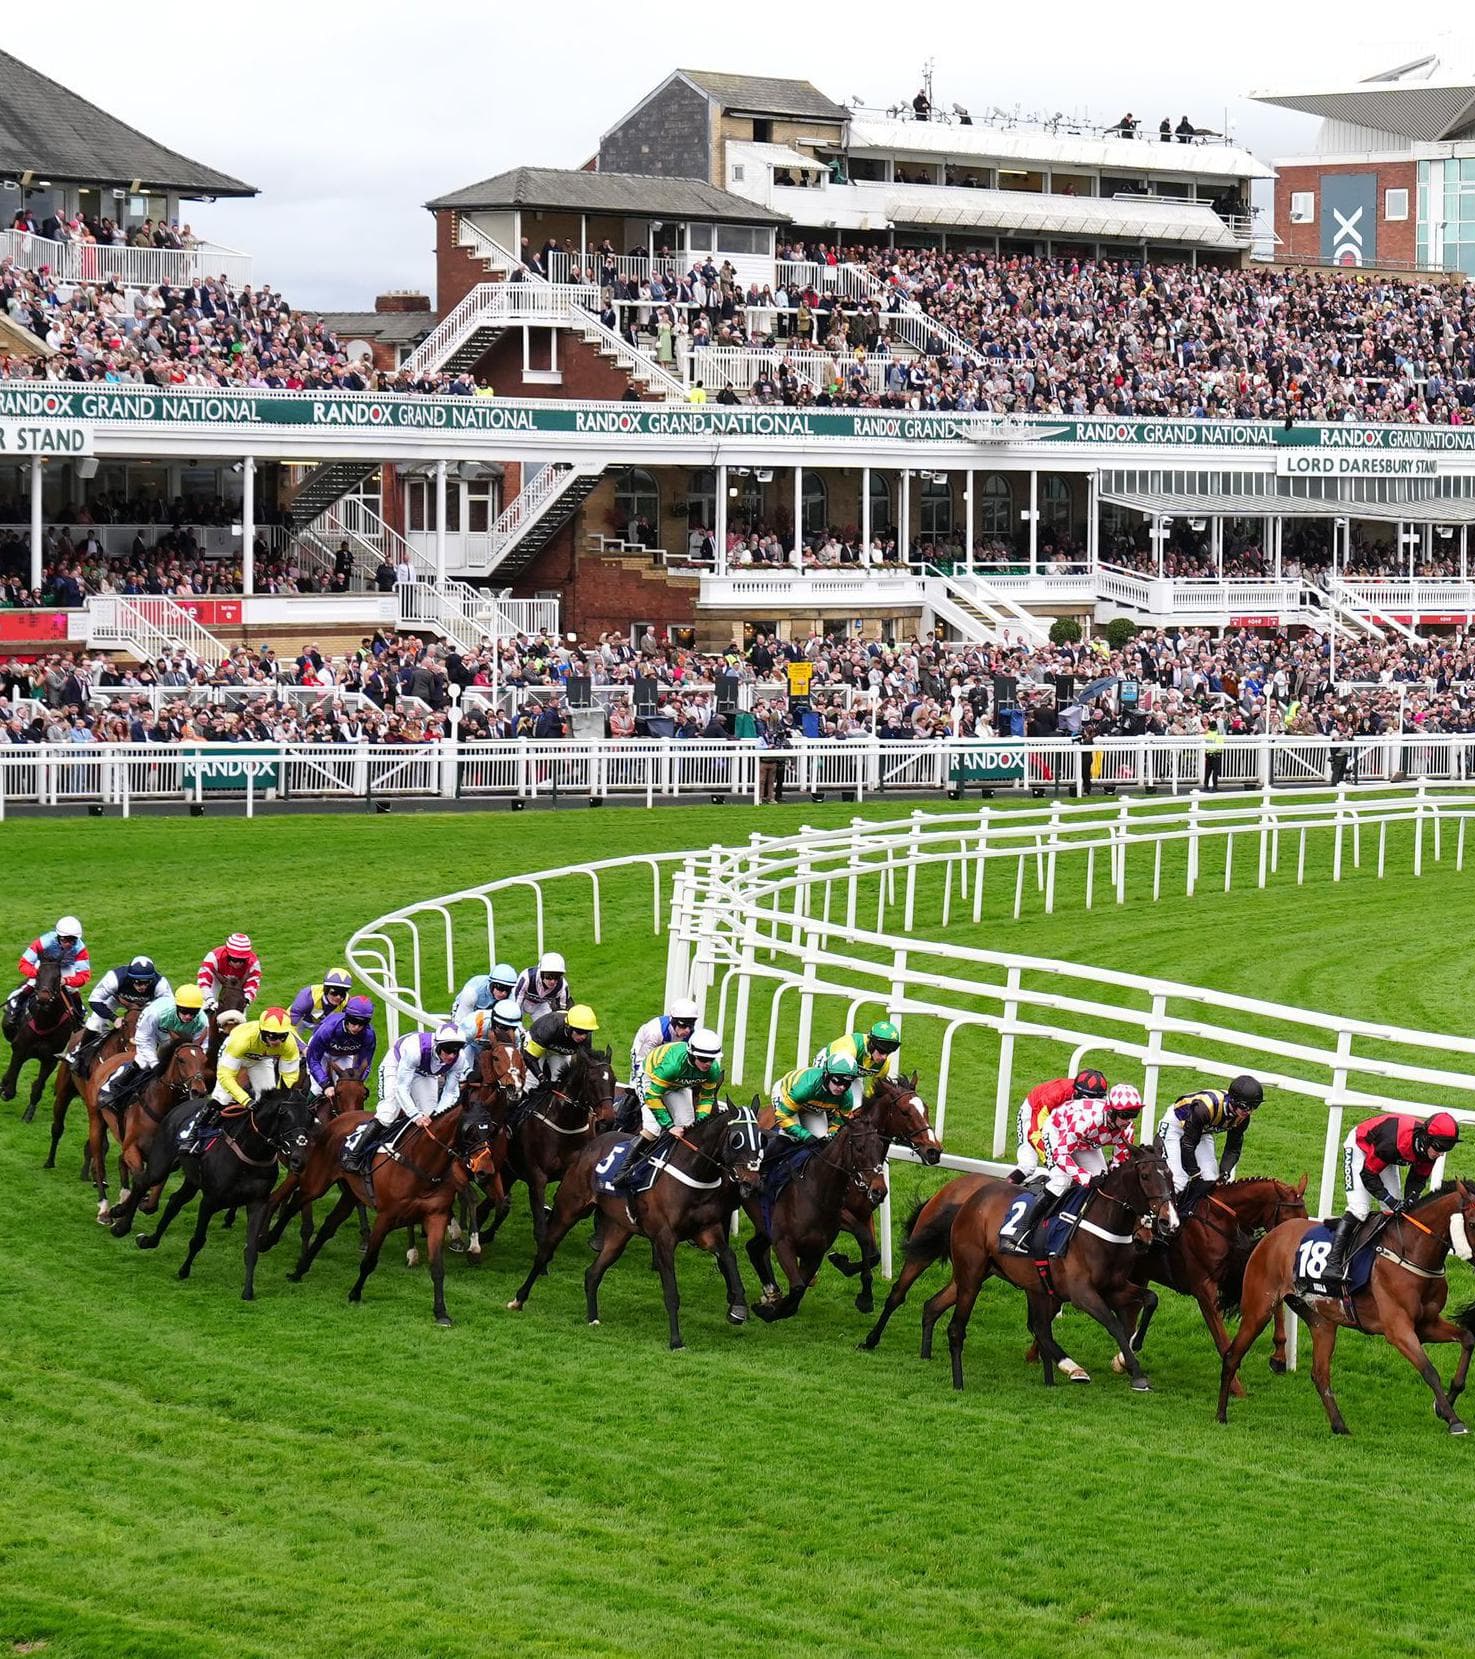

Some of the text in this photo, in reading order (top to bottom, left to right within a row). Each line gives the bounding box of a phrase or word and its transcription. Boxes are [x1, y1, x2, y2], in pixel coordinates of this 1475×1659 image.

[82, 397, 155, 419] GRAND
[163, 398, 262, 421] NATIONAL
[314, 402, 538, 430] RANDOX GRAND NATIONAL
[576, 412, 815, 434] RANDOX GRAND NATIONAL
[854, 419, 901, 437] RANDOX
[905, 420, 956, 439] GRAND
[1076, 422, 1278, 445] RANDOX GRAND NATIONAL
[17, 428, 84, 452] STAND
[1320, 428, 1384, 446] RANDOX
[1389, 430, 1422, 447] GRAND
[1287, 457, 1335, 473] LORD
[1340, 458, 1414, 474] DARESBURY
[951, 752, 1024, 770] RANDOX
[595, 1147, 625, 1173] 5
[1345, 1148, 1353, 1190] RANDOX
[1000, 1201, 1027, 1235] 2
[1299, 1240, 1332, 1279] 18
